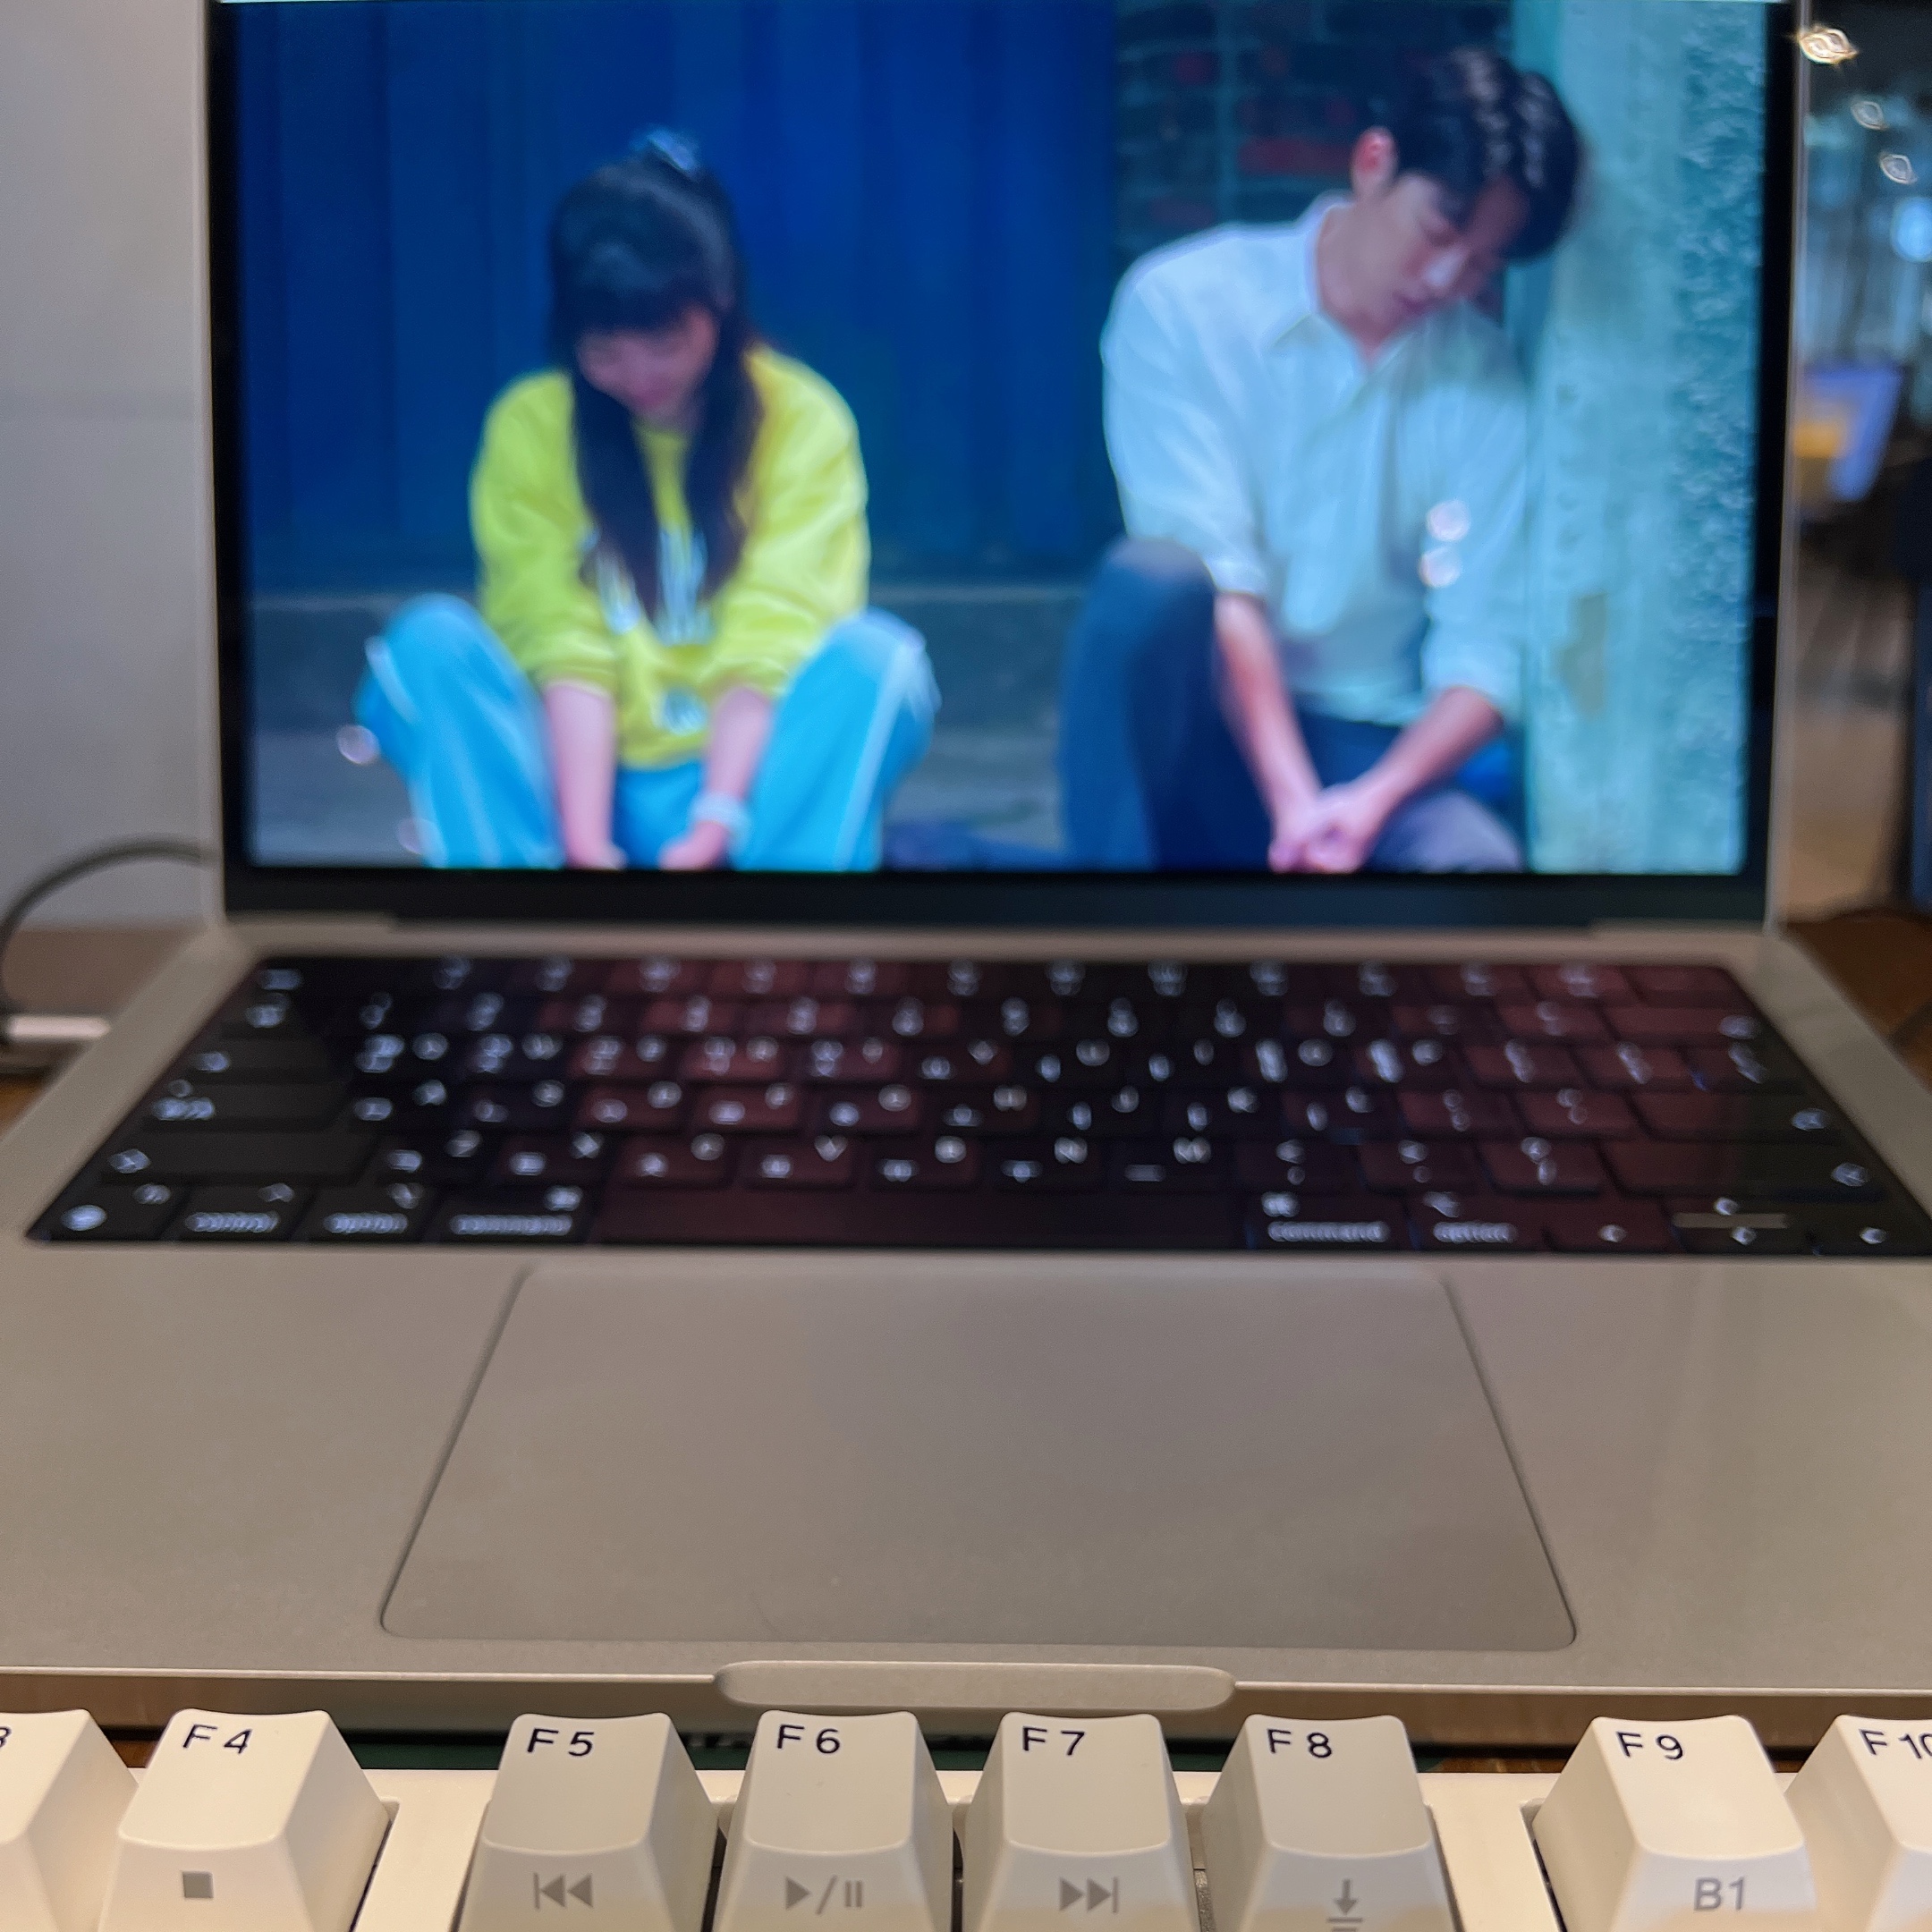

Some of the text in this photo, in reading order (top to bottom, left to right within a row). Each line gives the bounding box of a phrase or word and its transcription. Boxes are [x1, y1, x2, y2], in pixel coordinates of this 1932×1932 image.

[182, 1723, 253, 1755] F4
[526, 1727, 595, 1758] F5
[776, 1724, 841, 1755] F6
[1021, 1725, 1086, 1757] F7
[1267, 1728, 1333, 1759] F8
[1615, 1731, 1684, 1761] F9
[1693, 1877, 1746, 1912] B1
